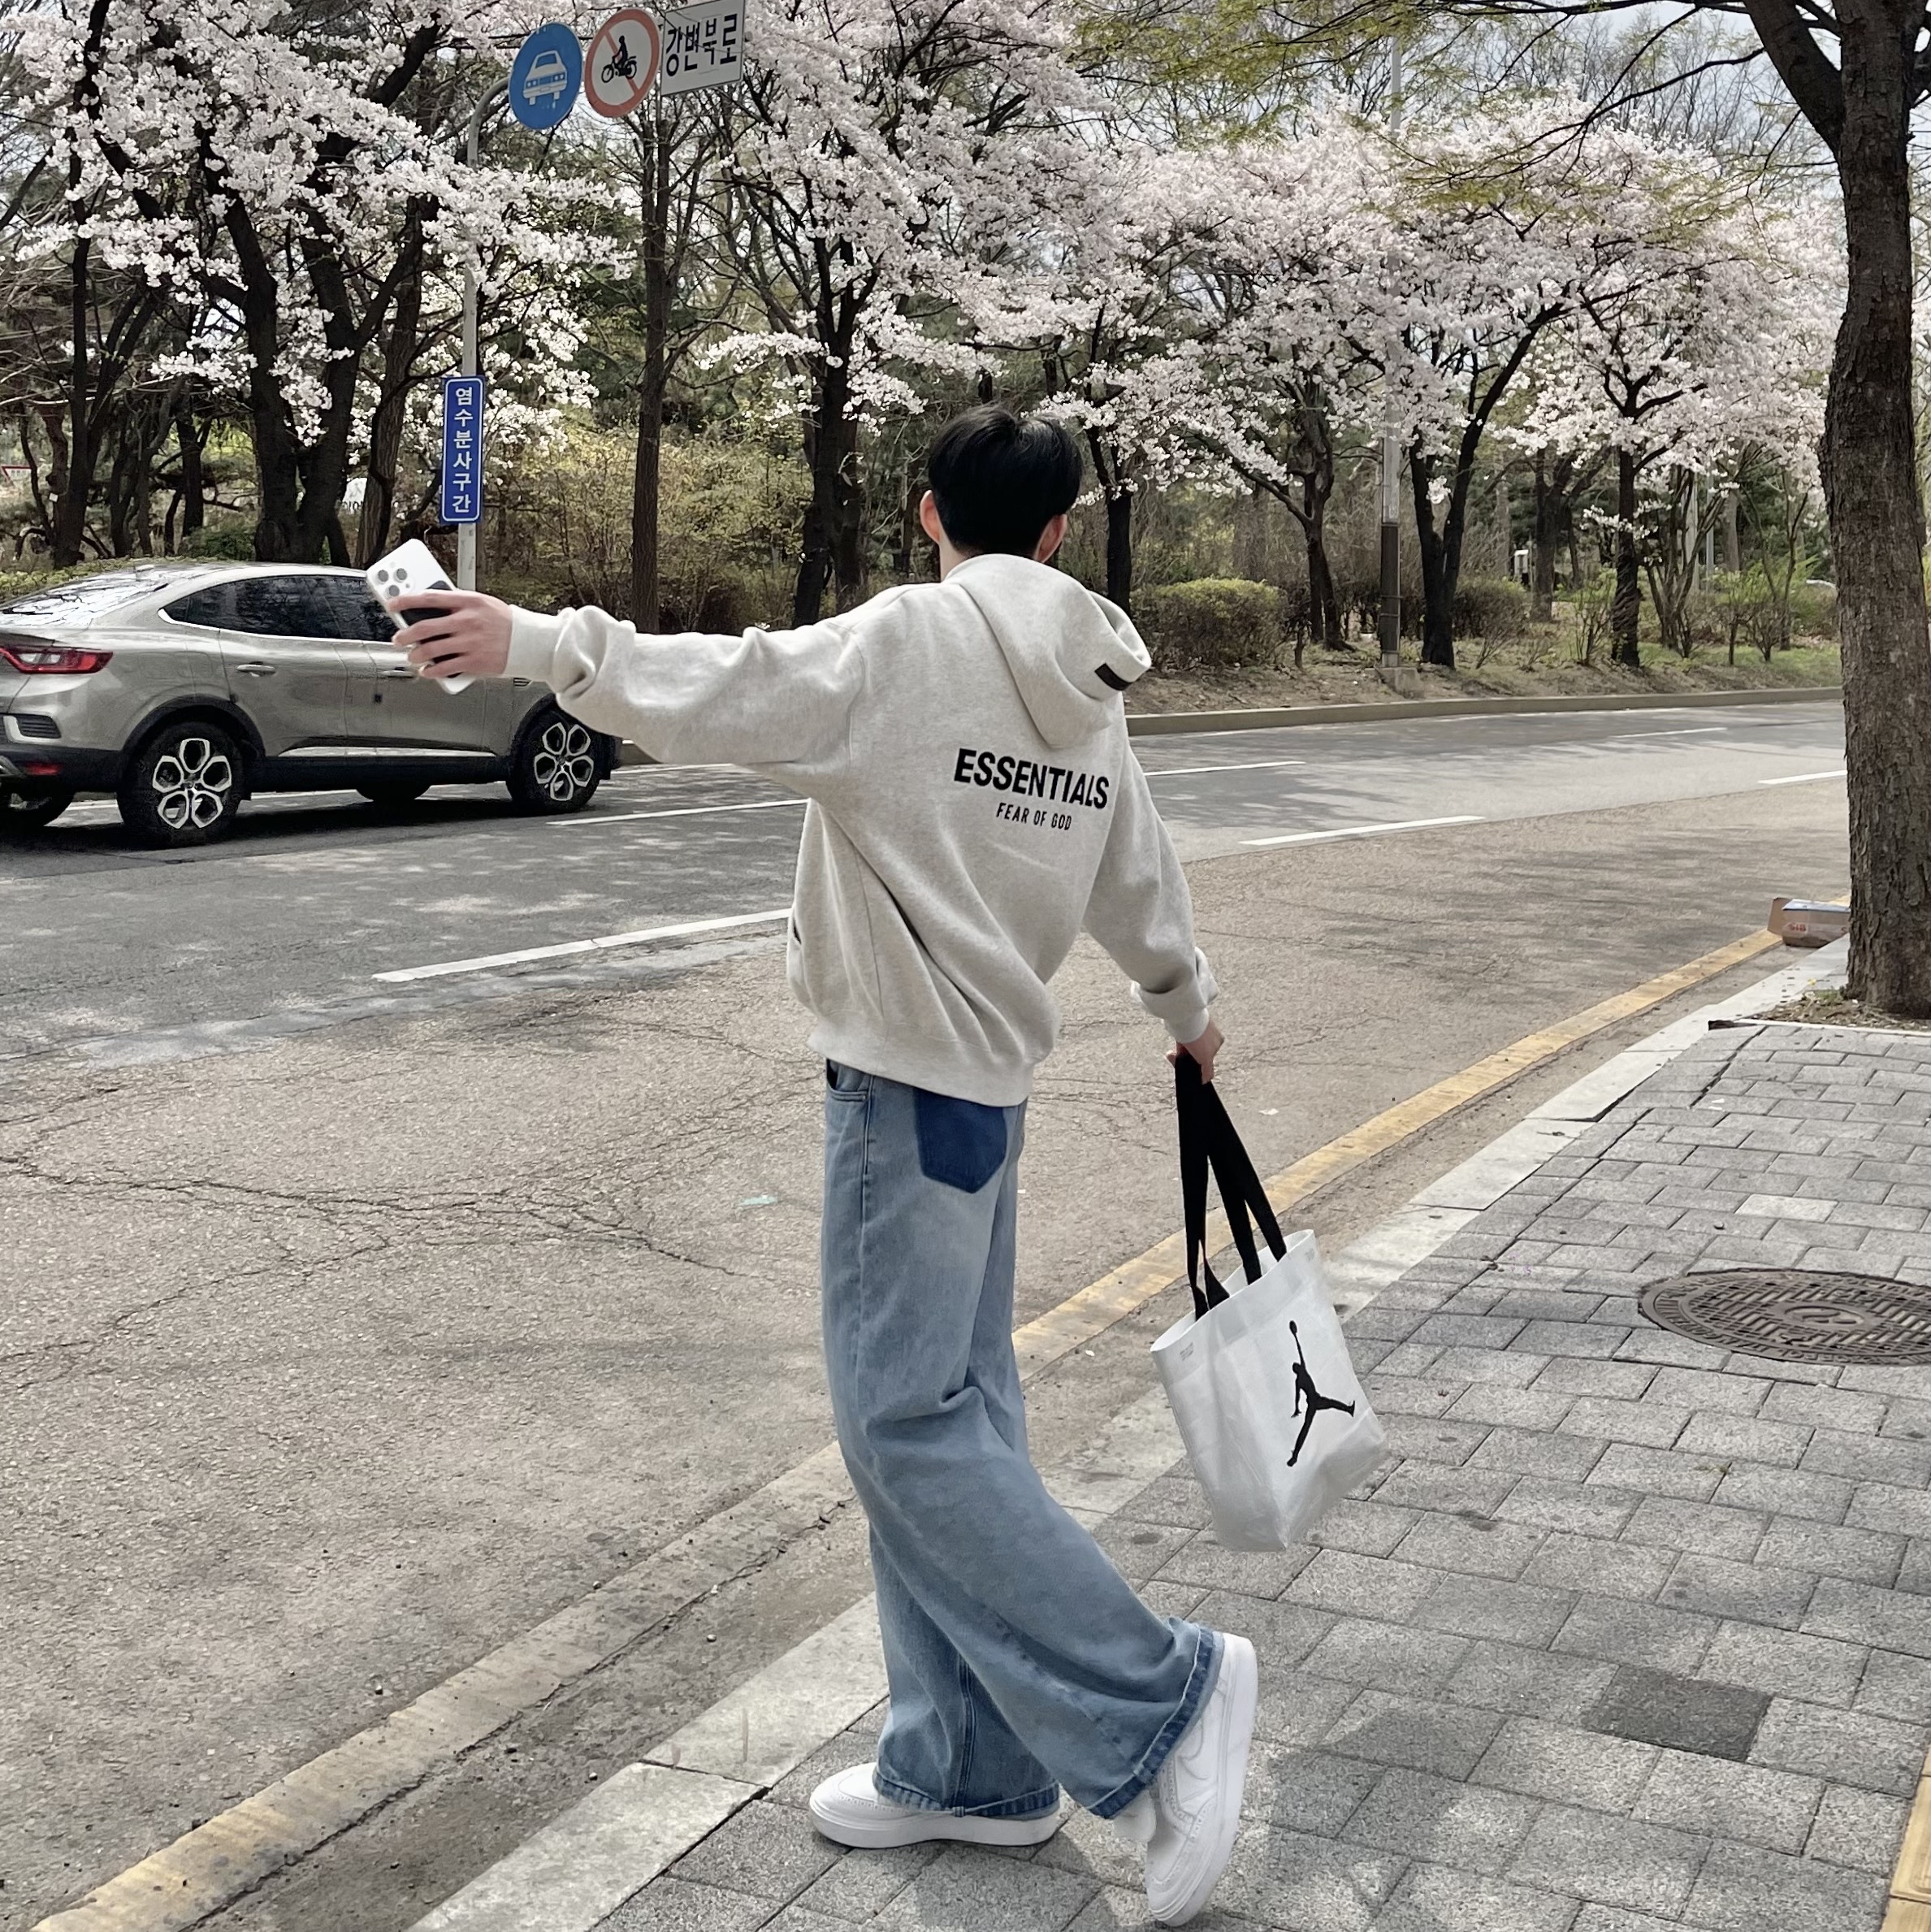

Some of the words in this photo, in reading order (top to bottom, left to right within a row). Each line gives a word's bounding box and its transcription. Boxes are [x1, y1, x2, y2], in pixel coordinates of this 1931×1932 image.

[665, 14, 737, 76] 강변북로
[452, 387, 473, 513] 염수분사구간
[954, 747, 1110, 809] ESSENTIALS
[996, 802, 1029, 824] FEAR
[1033, 809, 1048, 827] OF
[1051, 813, 1072, 830] GOD
